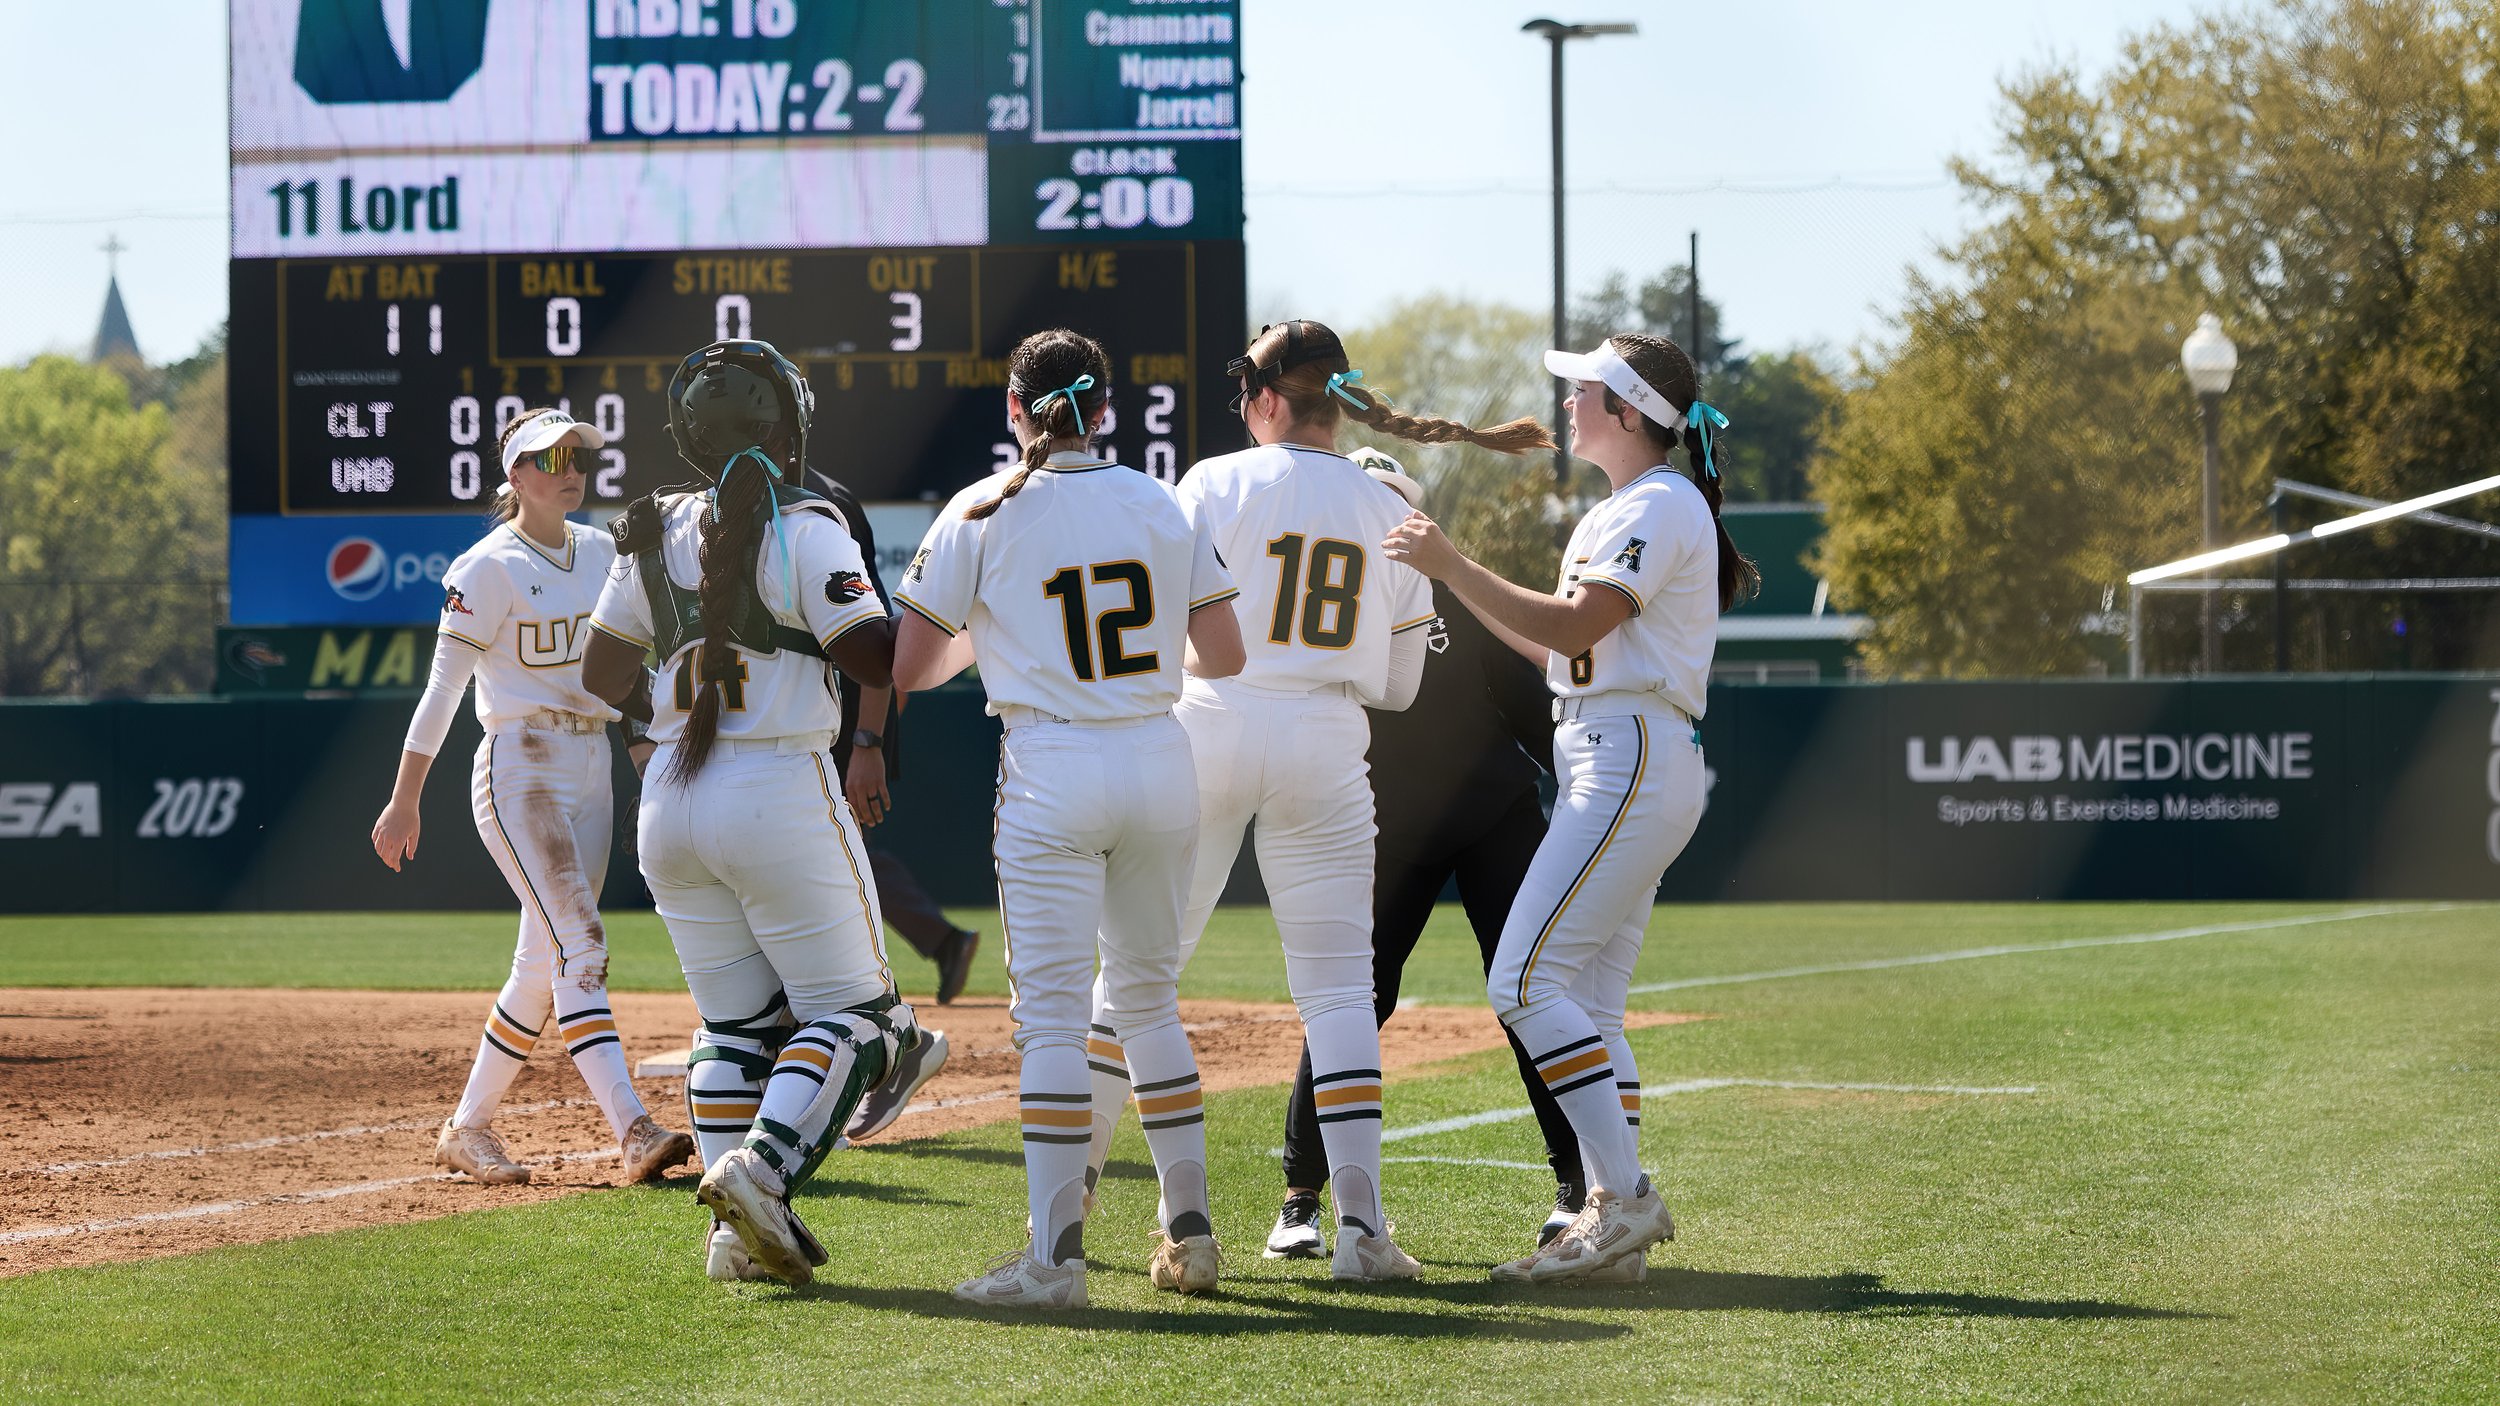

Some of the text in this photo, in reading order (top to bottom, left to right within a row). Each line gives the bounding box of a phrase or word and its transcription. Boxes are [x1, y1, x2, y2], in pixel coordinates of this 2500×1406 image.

[1119, 53, 1234, 90] Nguyen
[988, 94, 1030, 131] 23
[1070, 147, 1177, 176] CLOCK
[269, 176, 460, 236] 11 Lord
[1035, 177, 1194, 231] 2:00
[326, 264, 441, 300] AT BAT
[521, 261, 604, 297] BALL
[673, 258, 792, 295] STRIKE
[867, 256, 937, 292] OUT
[1058, 253, 1118, 288] H/E
[547, 297, 581, 356] 0
[889, 291, 922, 352] 3
[461, 367, 474, 393] 1
[502, 365, 519, 392] 2
[546, 364, 564, 392] 3
[602, 362, 618, 390] 4
[1130, 355, 1187, 385] ERR
[327, 401, 394, 437] CLT
[450, 396, 480, 445] 0
[596, 394, 625, 442] 0
[1145, 385, 1176, 434] 2
[450, 451, 481, 500] 0
[596, 449, 627, 497] 2
[1266, 532, 1367, 651] 18
[1042, 559, 1160, 682] 12
[310, 630, 417, 687] MA
[137, 777, 244, 838] 2013
[1938, 793, 2281, 827] Sports & Exercise Medicine
